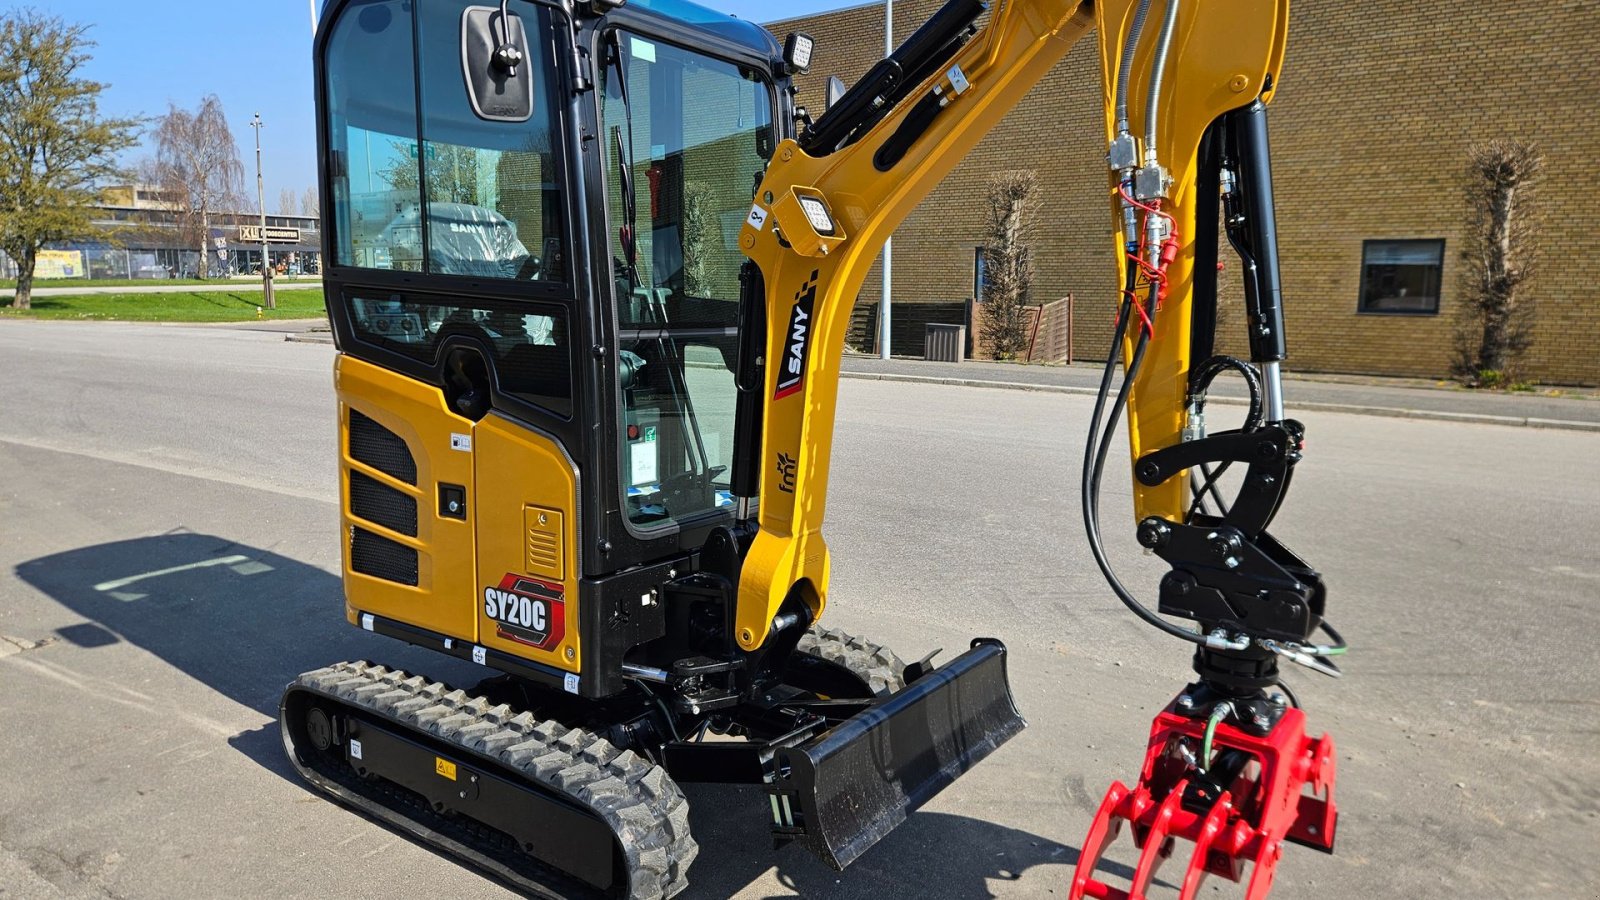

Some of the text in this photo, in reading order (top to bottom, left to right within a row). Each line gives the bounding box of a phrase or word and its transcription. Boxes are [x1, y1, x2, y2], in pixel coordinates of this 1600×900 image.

[450, 222, 483, 234] SANY
[788, 305, 808, 375] SANY
[778, 453, 796, 493] fmr
[485, 588, 546, 631] SY20C
